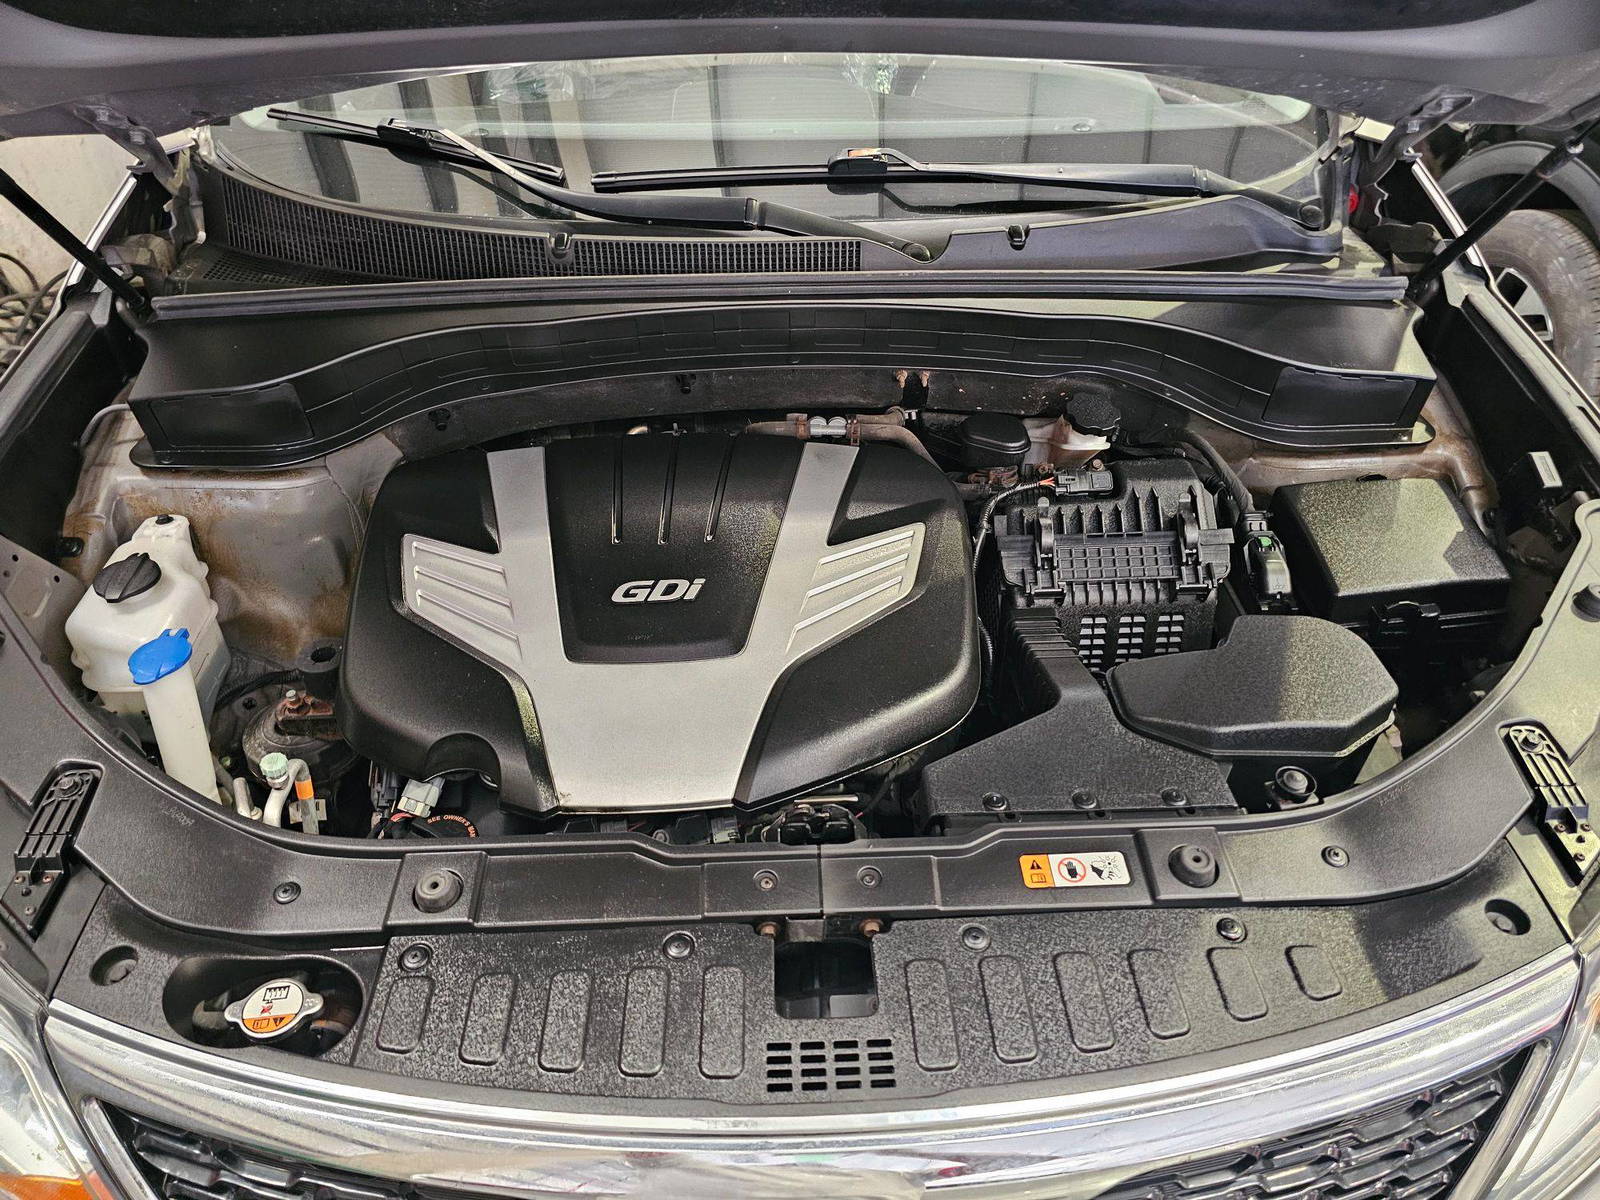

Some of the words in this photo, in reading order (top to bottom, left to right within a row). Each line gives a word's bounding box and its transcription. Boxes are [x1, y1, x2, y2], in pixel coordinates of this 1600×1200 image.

[611, 578, 706, 602] GDi
[427, 815, 441, 824] SEE
[443, 814, 471, 827] OWNER'S
